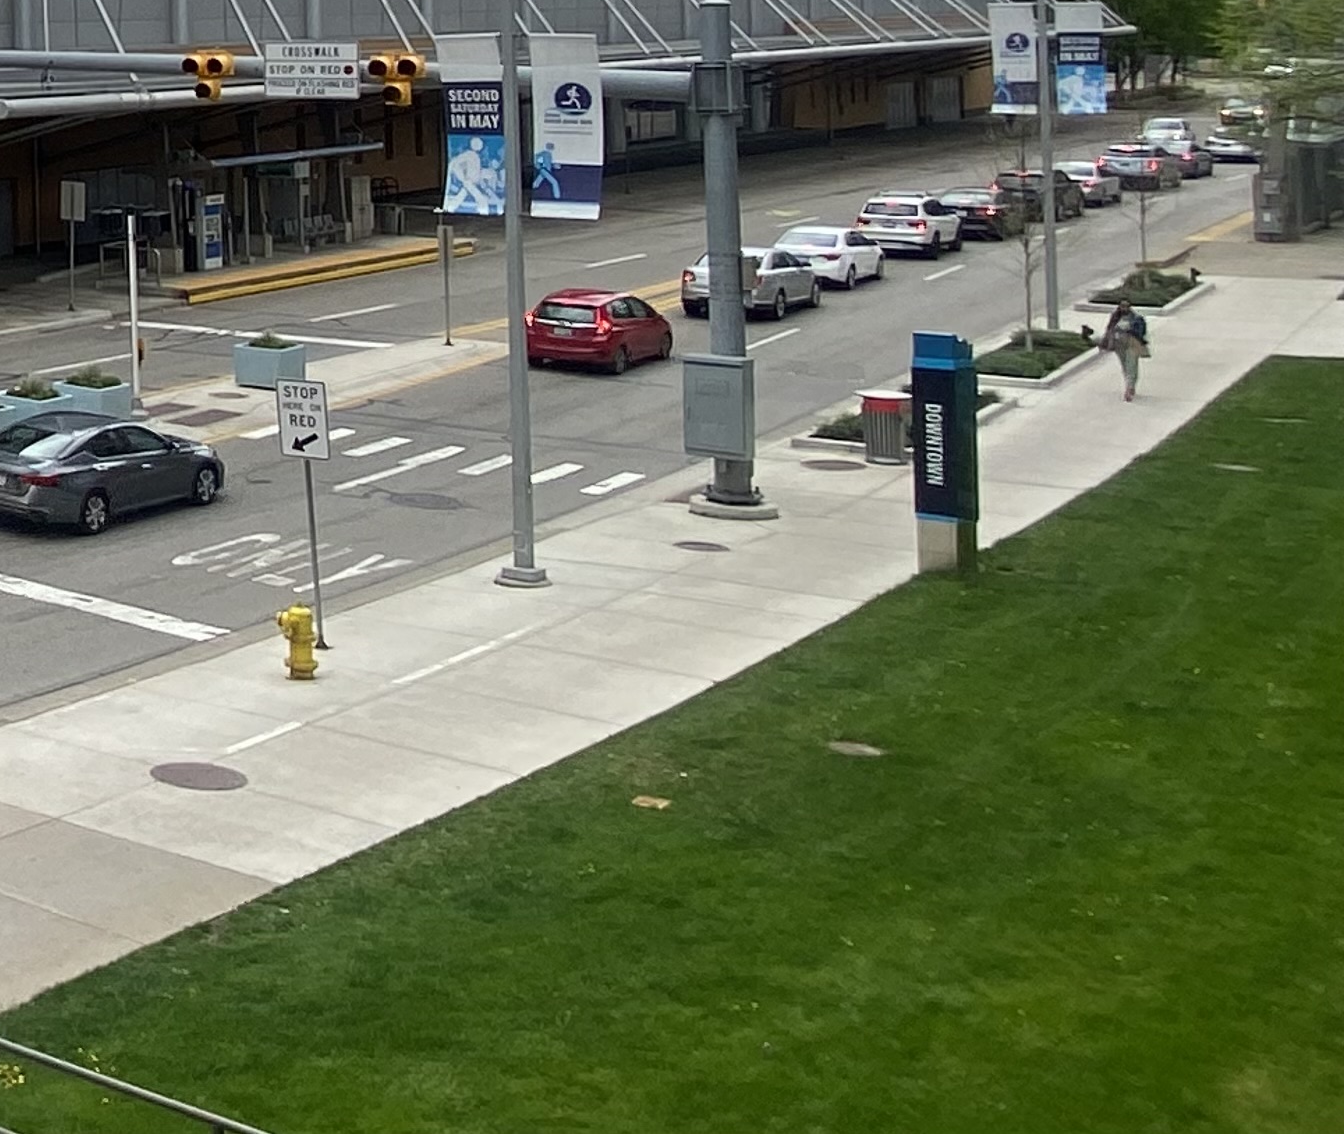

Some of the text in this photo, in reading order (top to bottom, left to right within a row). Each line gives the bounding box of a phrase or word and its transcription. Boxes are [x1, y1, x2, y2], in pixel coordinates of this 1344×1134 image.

[281, 47, 340, 57] CROSSWALK
[269, 65, 341, 75] STOP ON RED
[448, 89, 499, 102] SECOND
[451, 114, 499, 128] IN MAY
[283, 385, 318, 400] STOP
[289, 414, 317, 428] RED
[925, 403, 944, 487] DOWNTOWN
